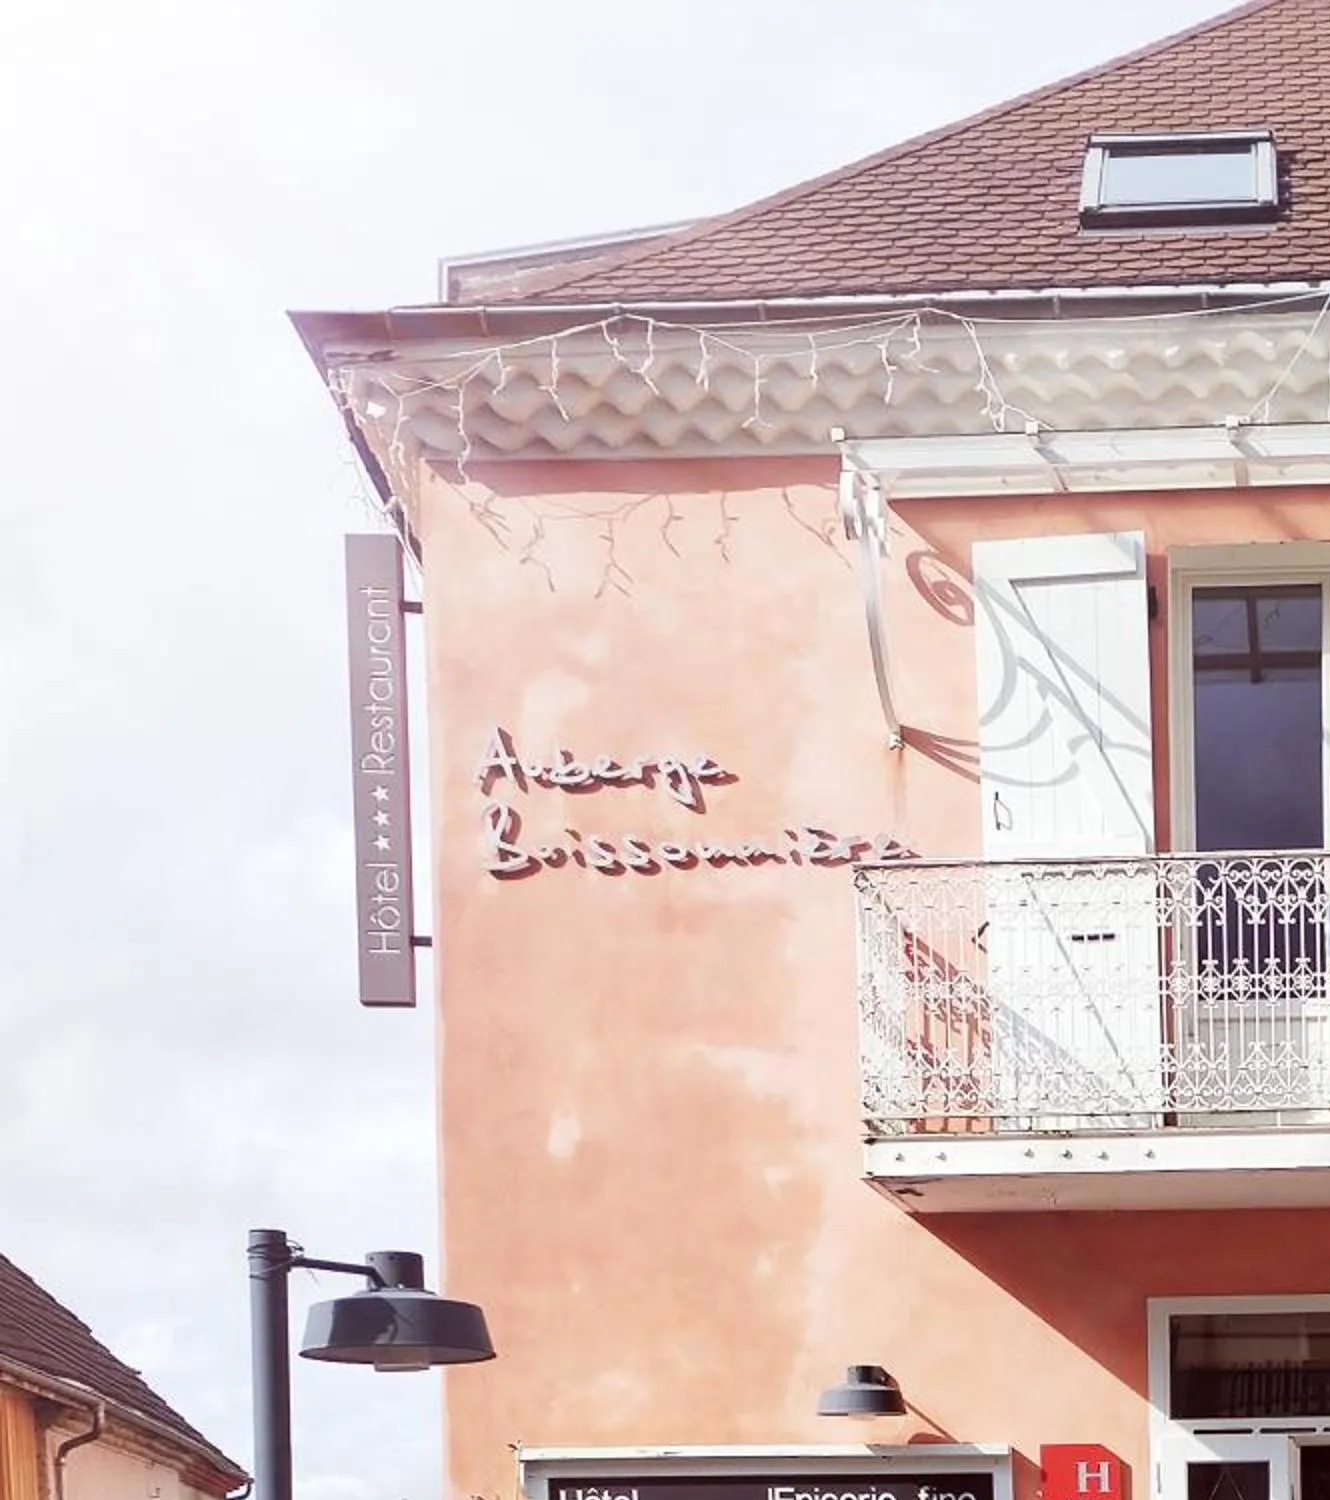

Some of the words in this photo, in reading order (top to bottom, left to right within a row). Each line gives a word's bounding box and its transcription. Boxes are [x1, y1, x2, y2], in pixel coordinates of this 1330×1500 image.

[360, 586, 396, 775] Restaurant
[478, 728, 736, 812] Auberge
[366, 863, 400, 954] Hôtel
[1075, 1460, 1113, 1493] H
